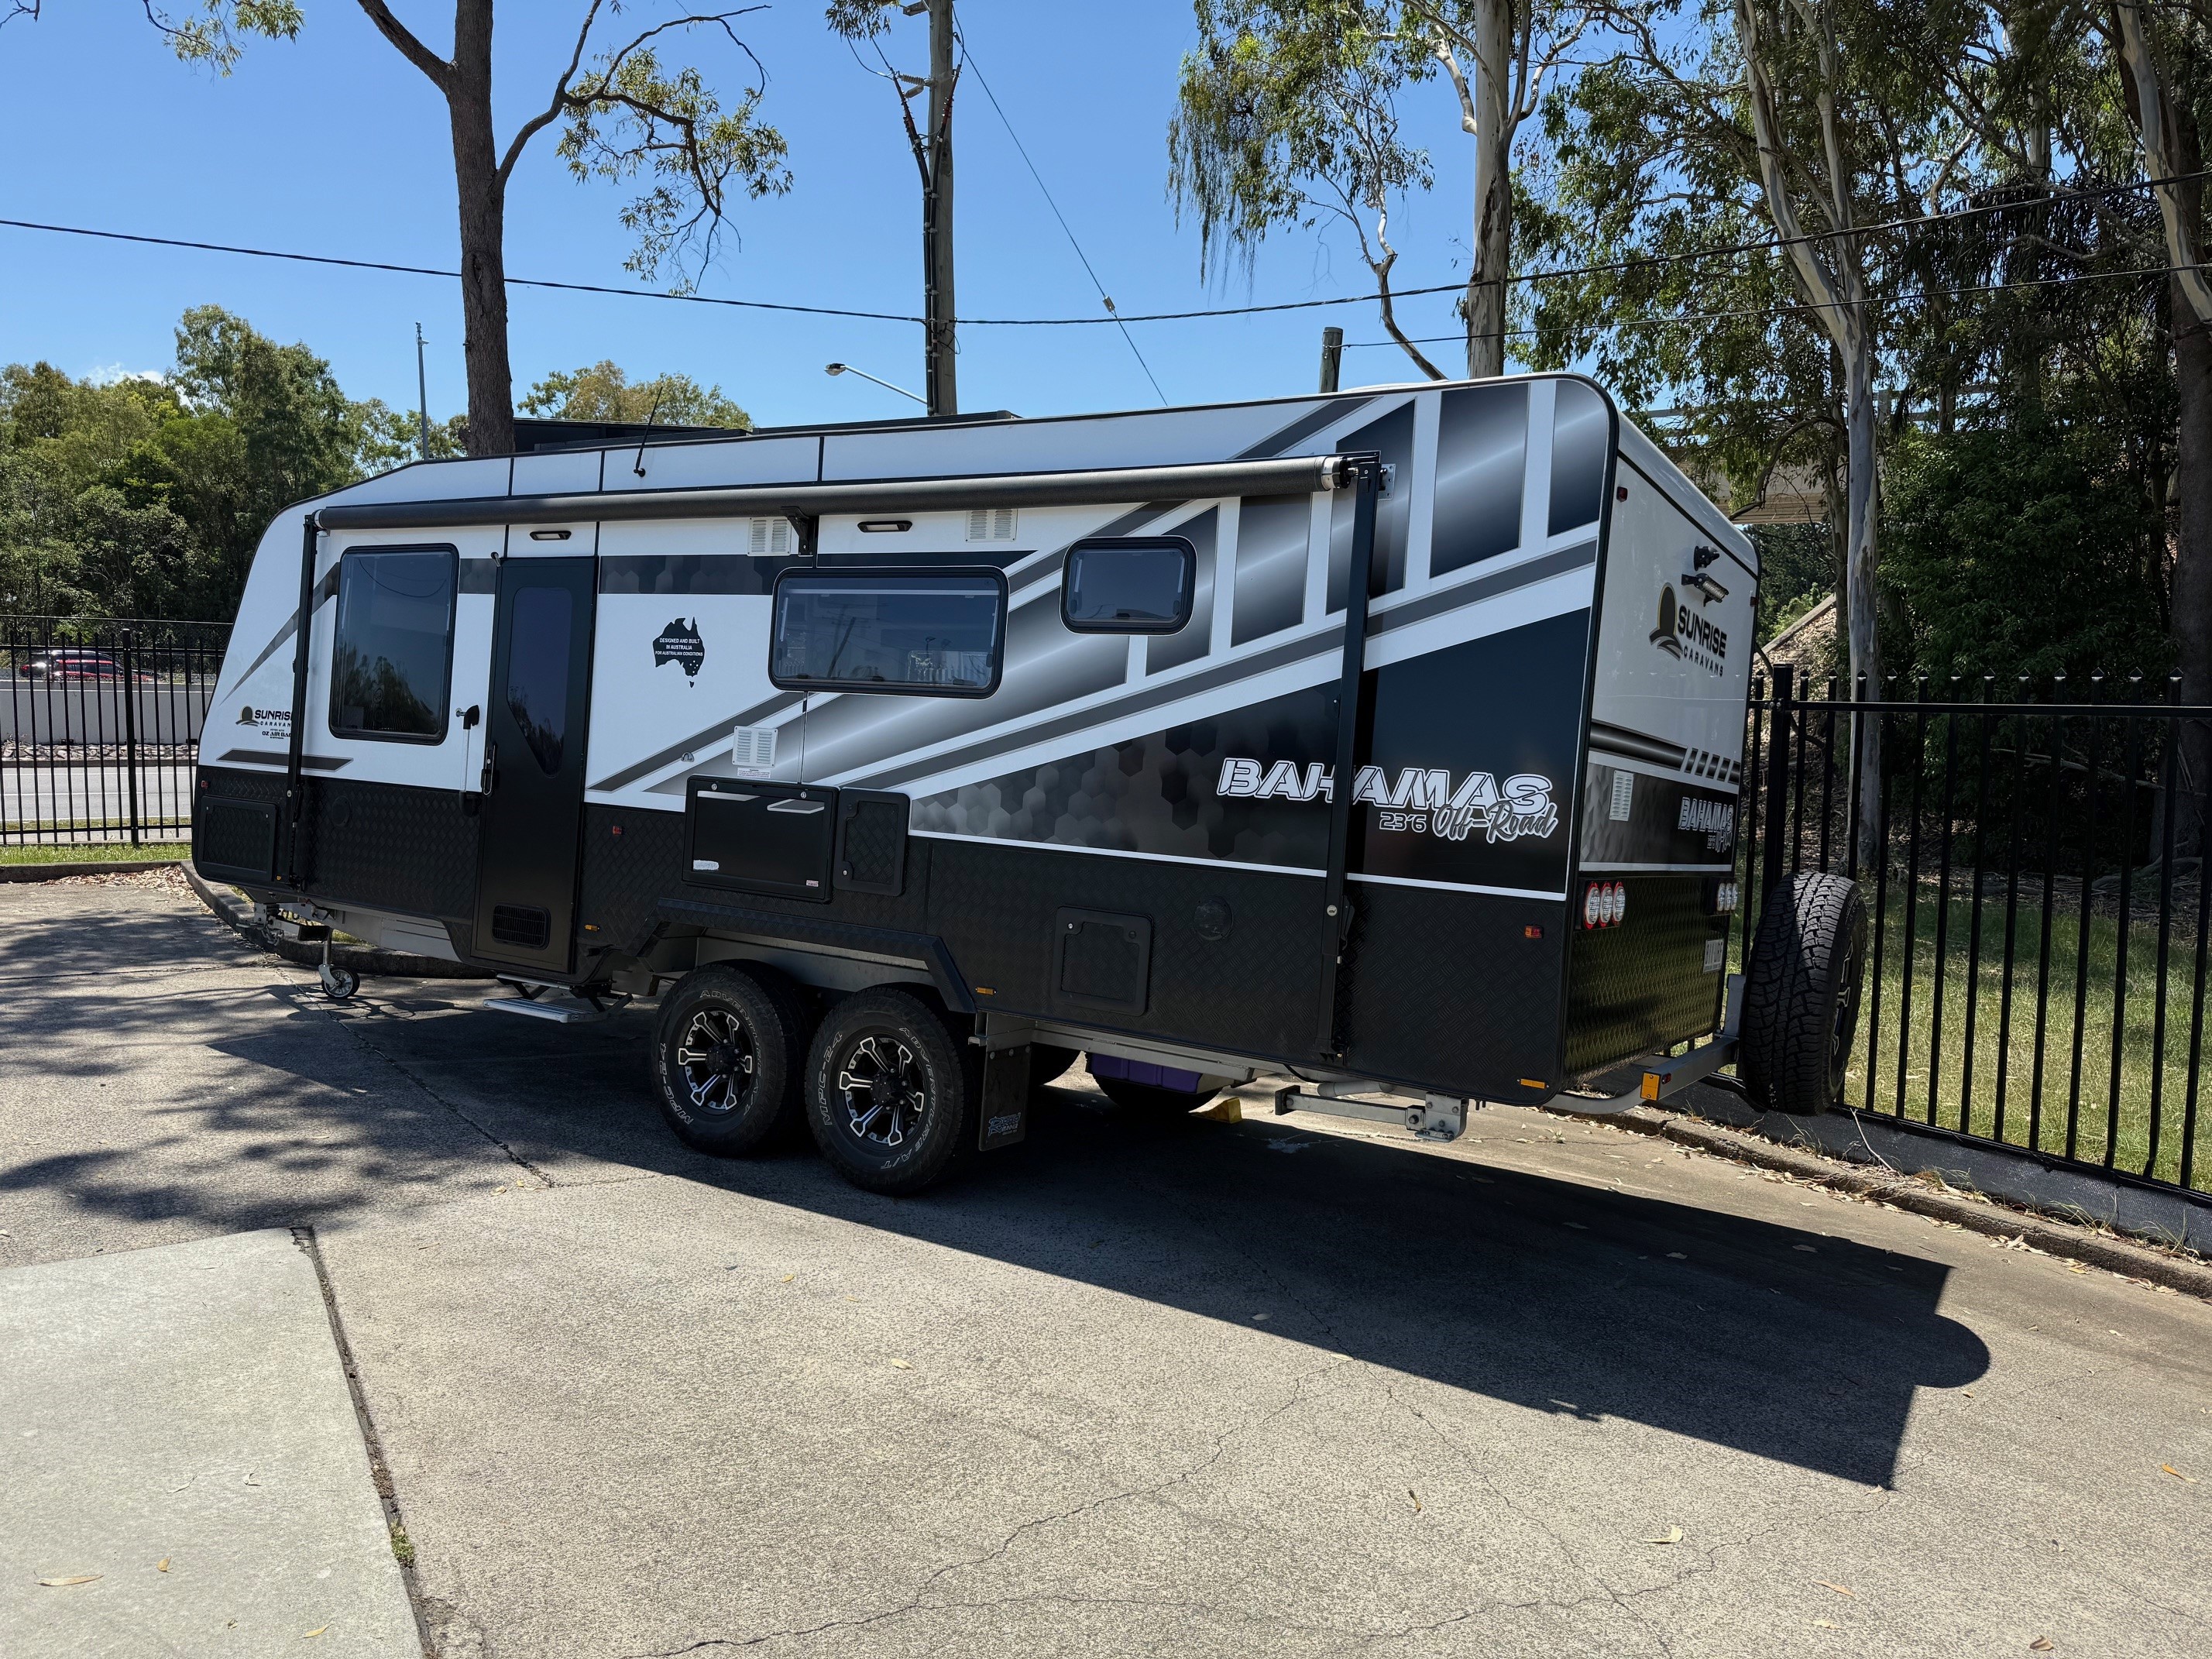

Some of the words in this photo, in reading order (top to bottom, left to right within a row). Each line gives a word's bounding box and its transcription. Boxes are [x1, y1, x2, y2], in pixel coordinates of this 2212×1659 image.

[1678, 604, 1727, 659] SUNRISE
[1683, 645, 1723, 677] CARAVANS
[255, 709, 291, 720] SUNRIS
[1216, 757, 1553, 815] BAHAMAS
[1432, 802, 1558, 844] Off-Road
[1678, 797, 1734, 832] BAHAMAS
[699, 989, 763, 1077] ADVENTURE
[659, 1042, 694, 1125] MPC-24
[818, 1031, 843, 1125] MPC-24
[898, 1027, 936, 1152] ADVENTURE
[880, 1148, 912, 1170] A/T
